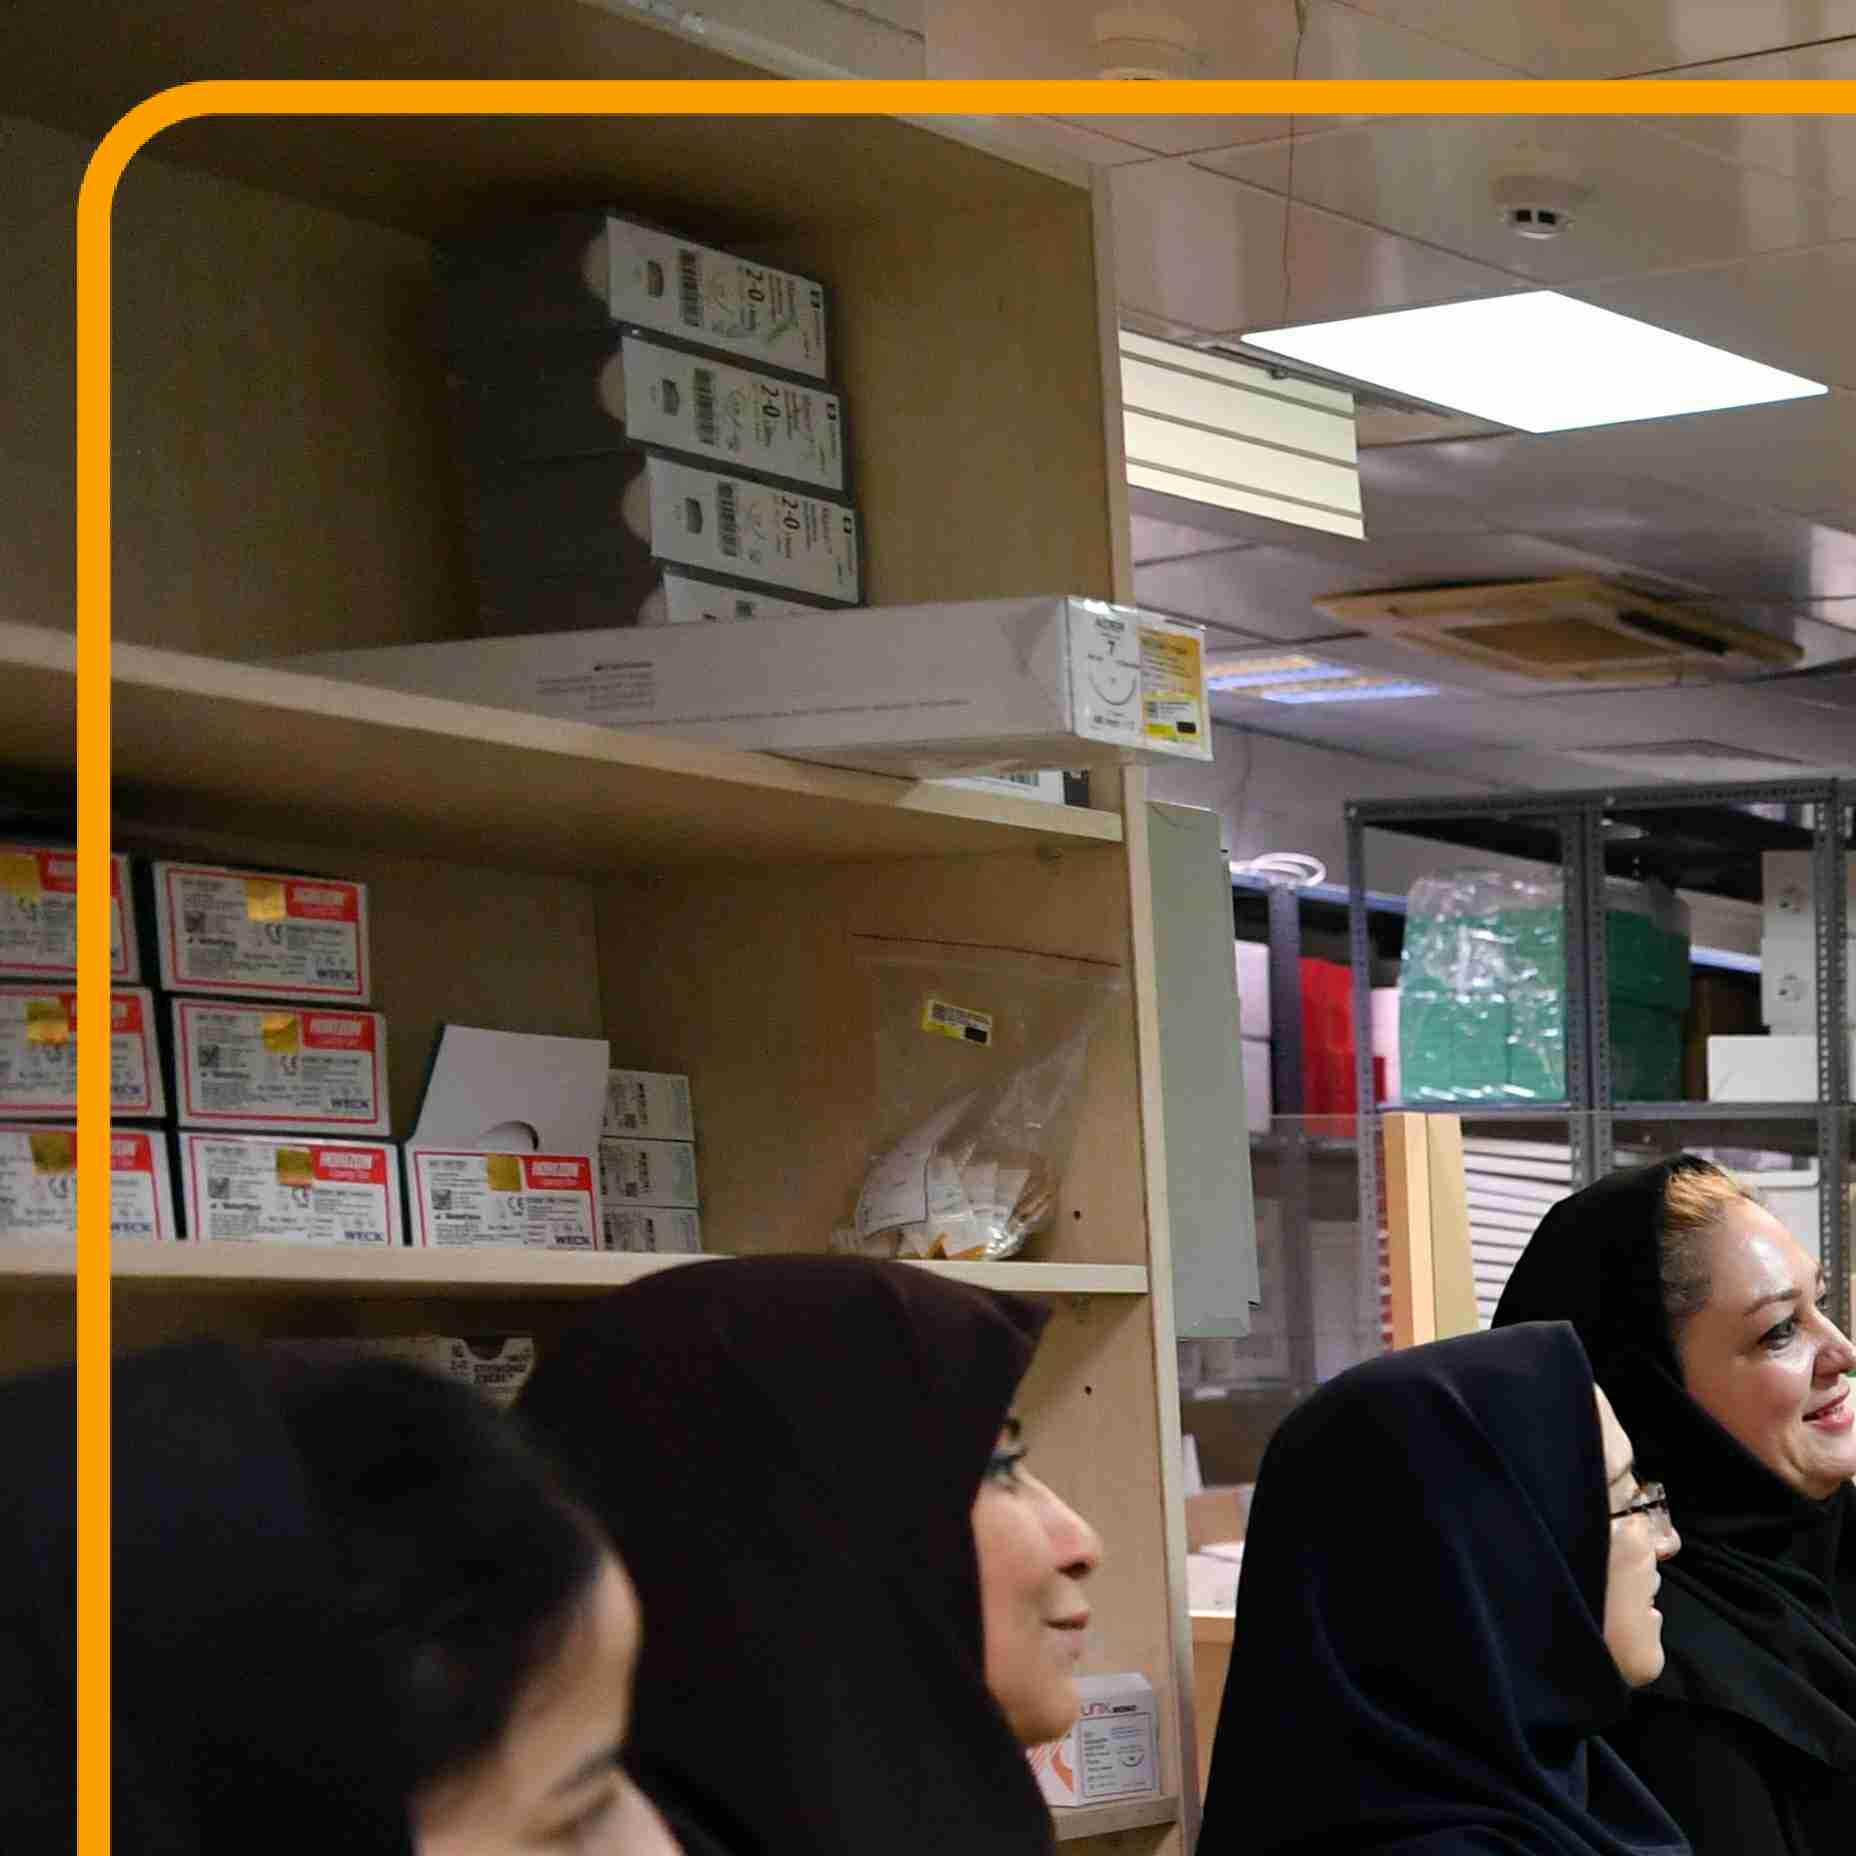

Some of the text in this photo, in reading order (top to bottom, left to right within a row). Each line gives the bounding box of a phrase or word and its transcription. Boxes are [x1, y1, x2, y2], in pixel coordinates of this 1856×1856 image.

[782, 495, 800, 530] 2-0
[344, 1230, 385, 1242] WECK
[554, 1235, 591, 1246] WECK
